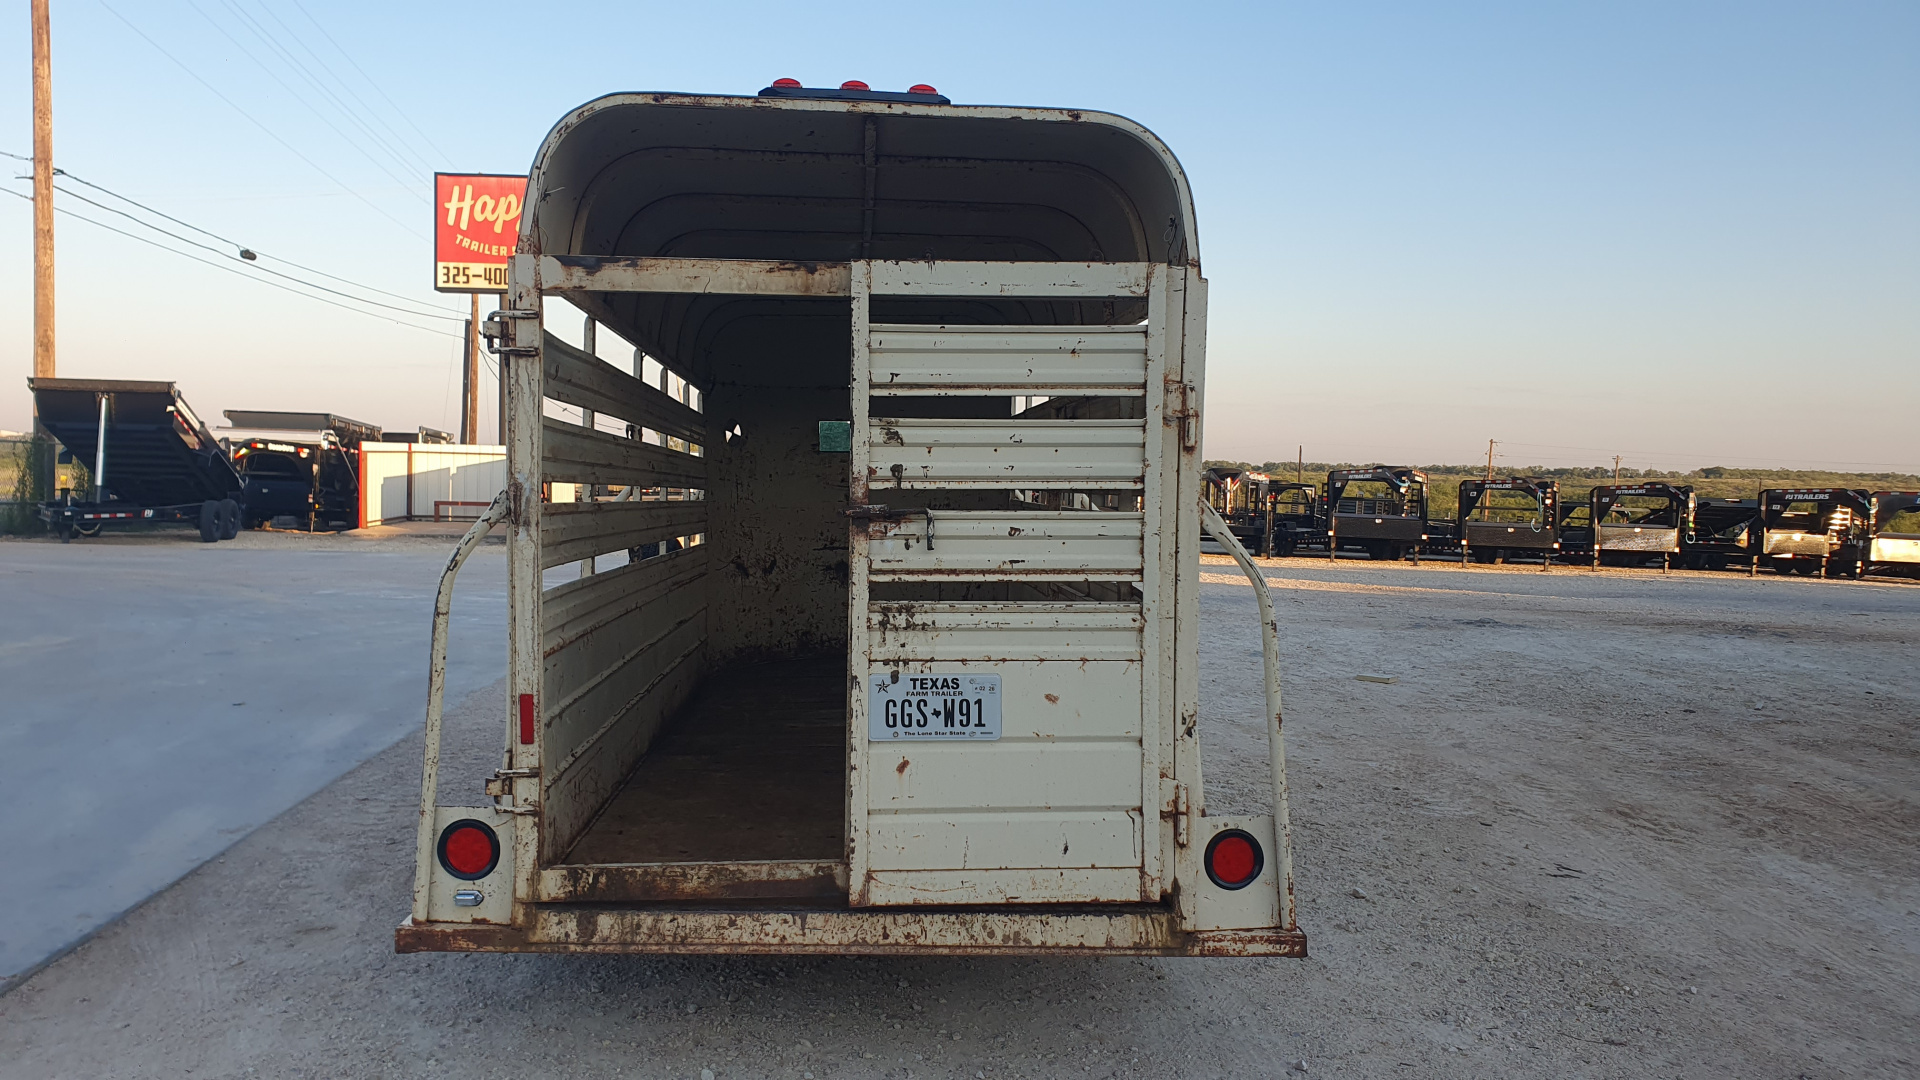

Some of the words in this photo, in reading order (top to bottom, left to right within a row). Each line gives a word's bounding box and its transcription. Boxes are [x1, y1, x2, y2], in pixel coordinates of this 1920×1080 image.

[444, 184, 523, 234] Hap
[455, 233, 508, 256] TRAILER
[910, 677, 960, 690] TEXAS
[885, 698, 928, 728] GGS
[943, 698, 986, 728] W91
